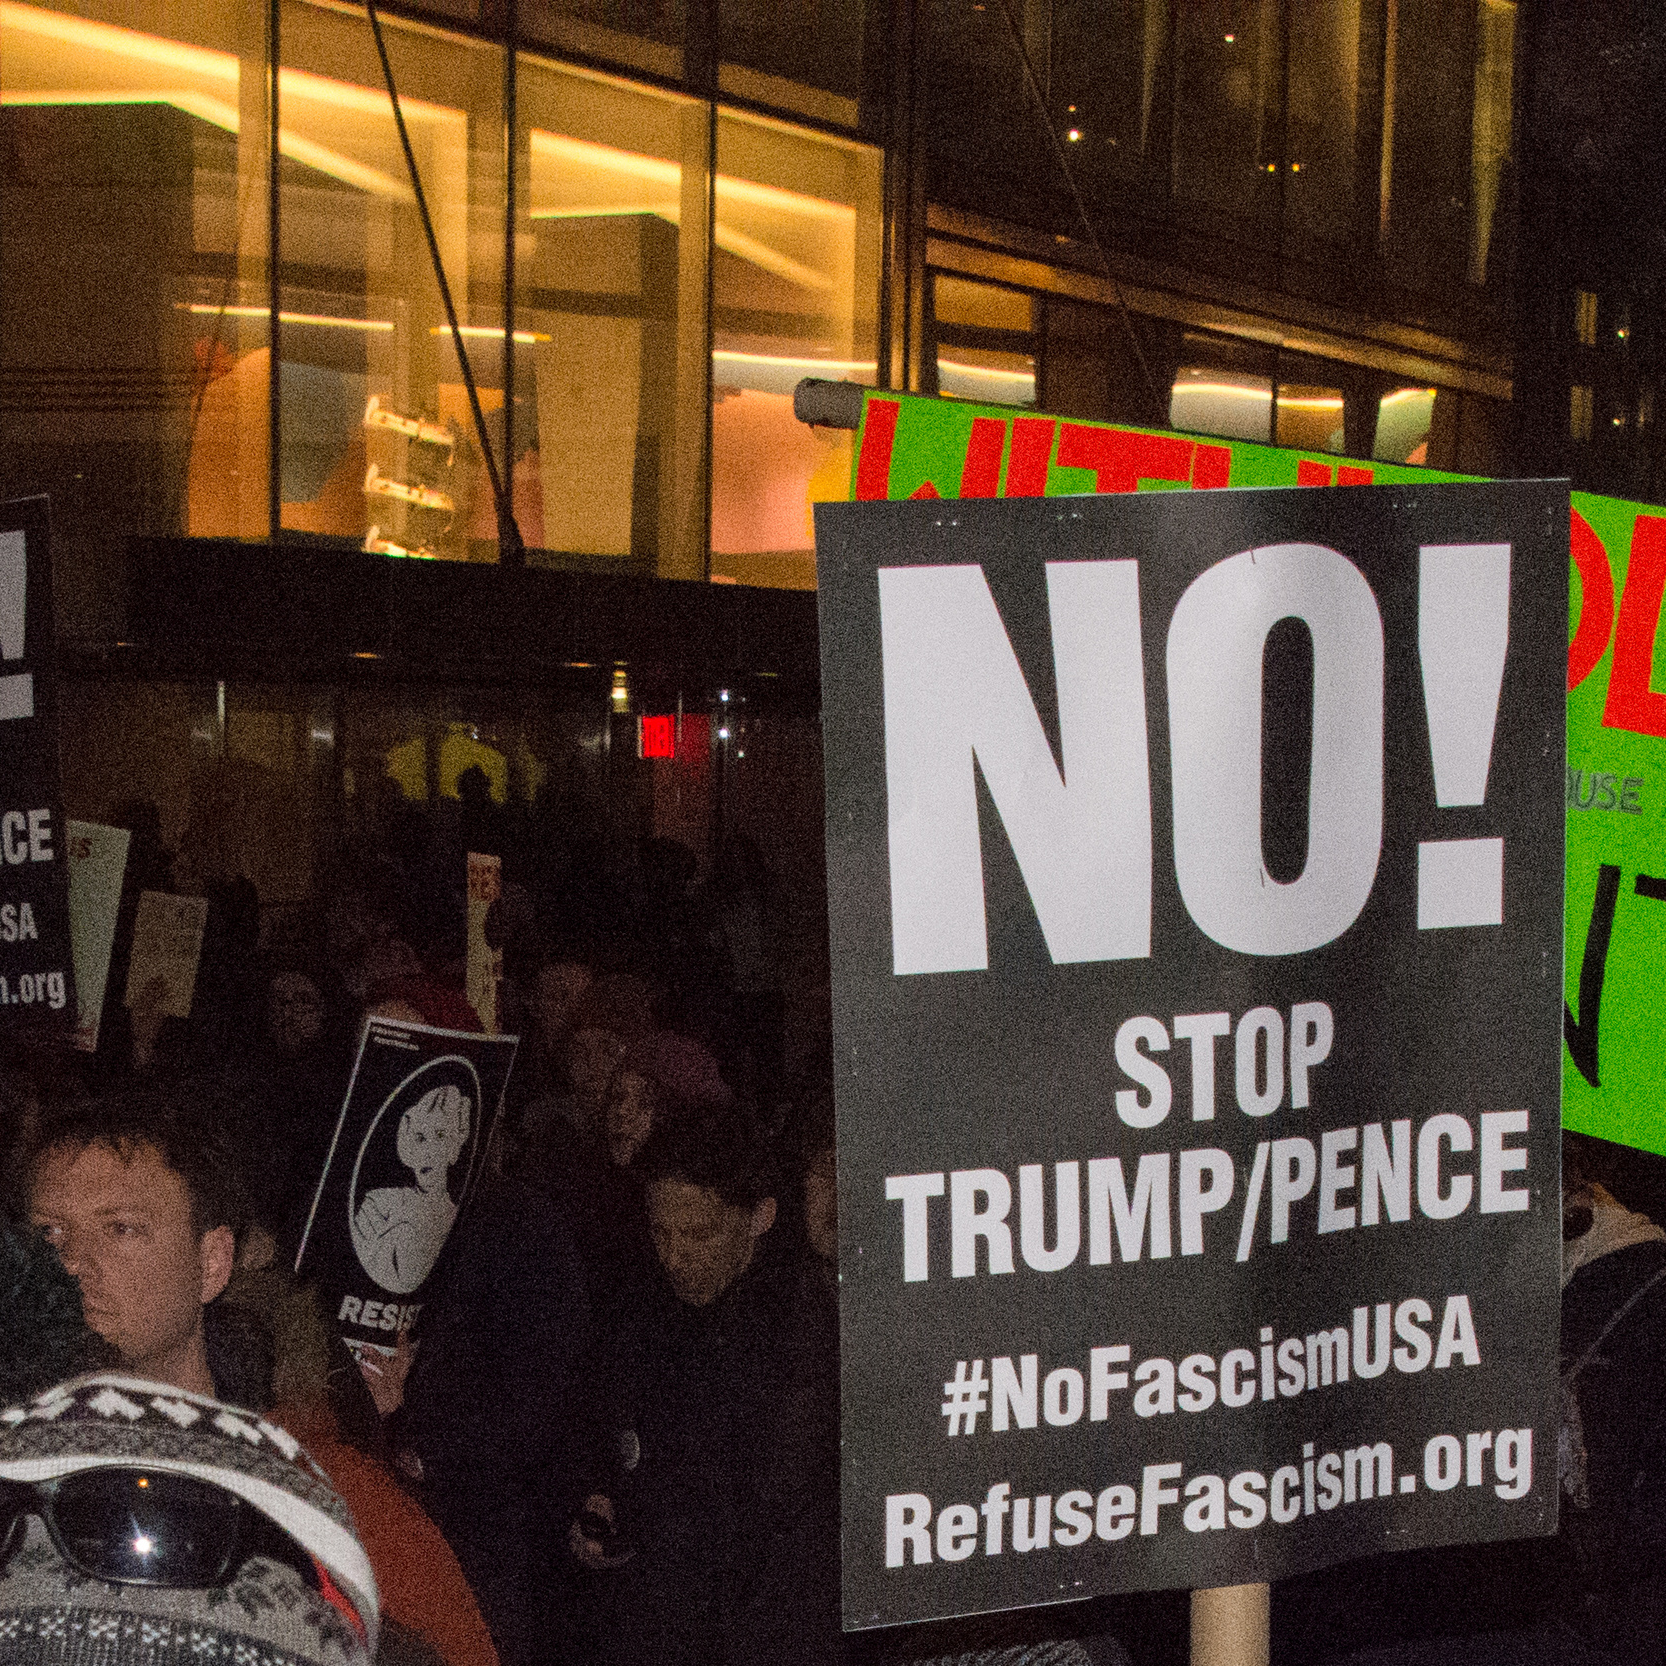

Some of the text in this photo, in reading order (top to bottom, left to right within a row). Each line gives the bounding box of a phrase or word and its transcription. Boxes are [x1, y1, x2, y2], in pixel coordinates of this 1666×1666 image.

[878, 542, 1511, 976] NO!
[1114, 1001, 1333, 1129] STOP
[885, 1109, 1530, 1282] TRUMP/PENCE
[941, 1294, 1482, 1436] #NoFascismUSA
[885, 1427, 1533, 1569] RefuseFascism.org
